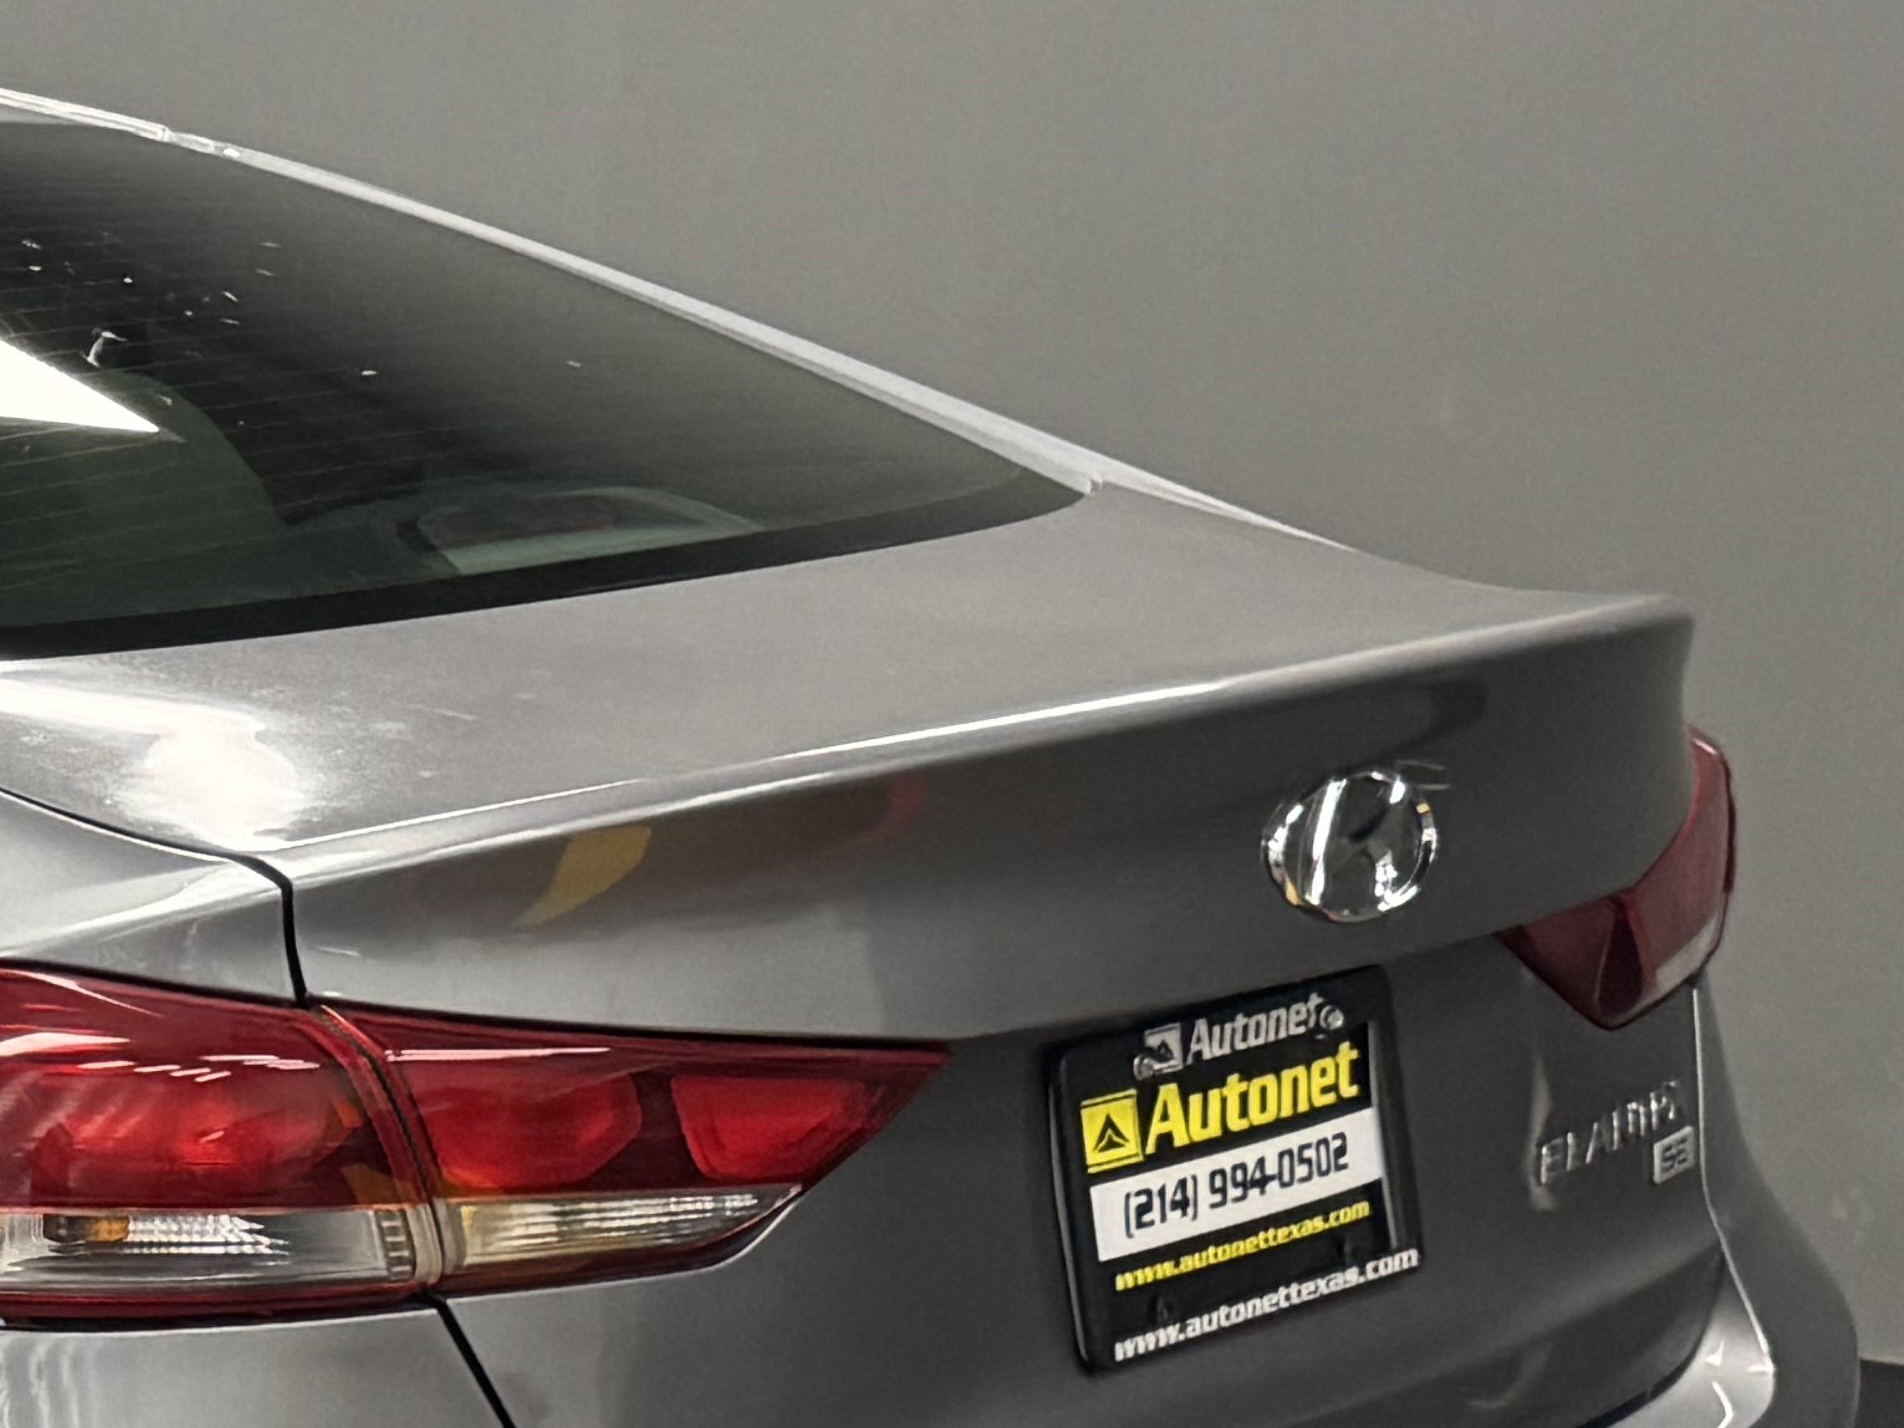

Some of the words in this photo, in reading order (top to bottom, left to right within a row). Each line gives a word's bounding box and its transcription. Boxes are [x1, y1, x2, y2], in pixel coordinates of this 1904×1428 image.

[1186, 992, 1324, 1063] Autonet
[1145, 1041, 1360, 1155] Autonet
[1124, 1173, 1199, 1239] (214)
[1209, 1131, 1349, 1210] 994-0502
[1115, 1201, 1371, 1291] www.autonettexas.com
[1114, 1248, 1420, 1362] www.autonettexas.com
